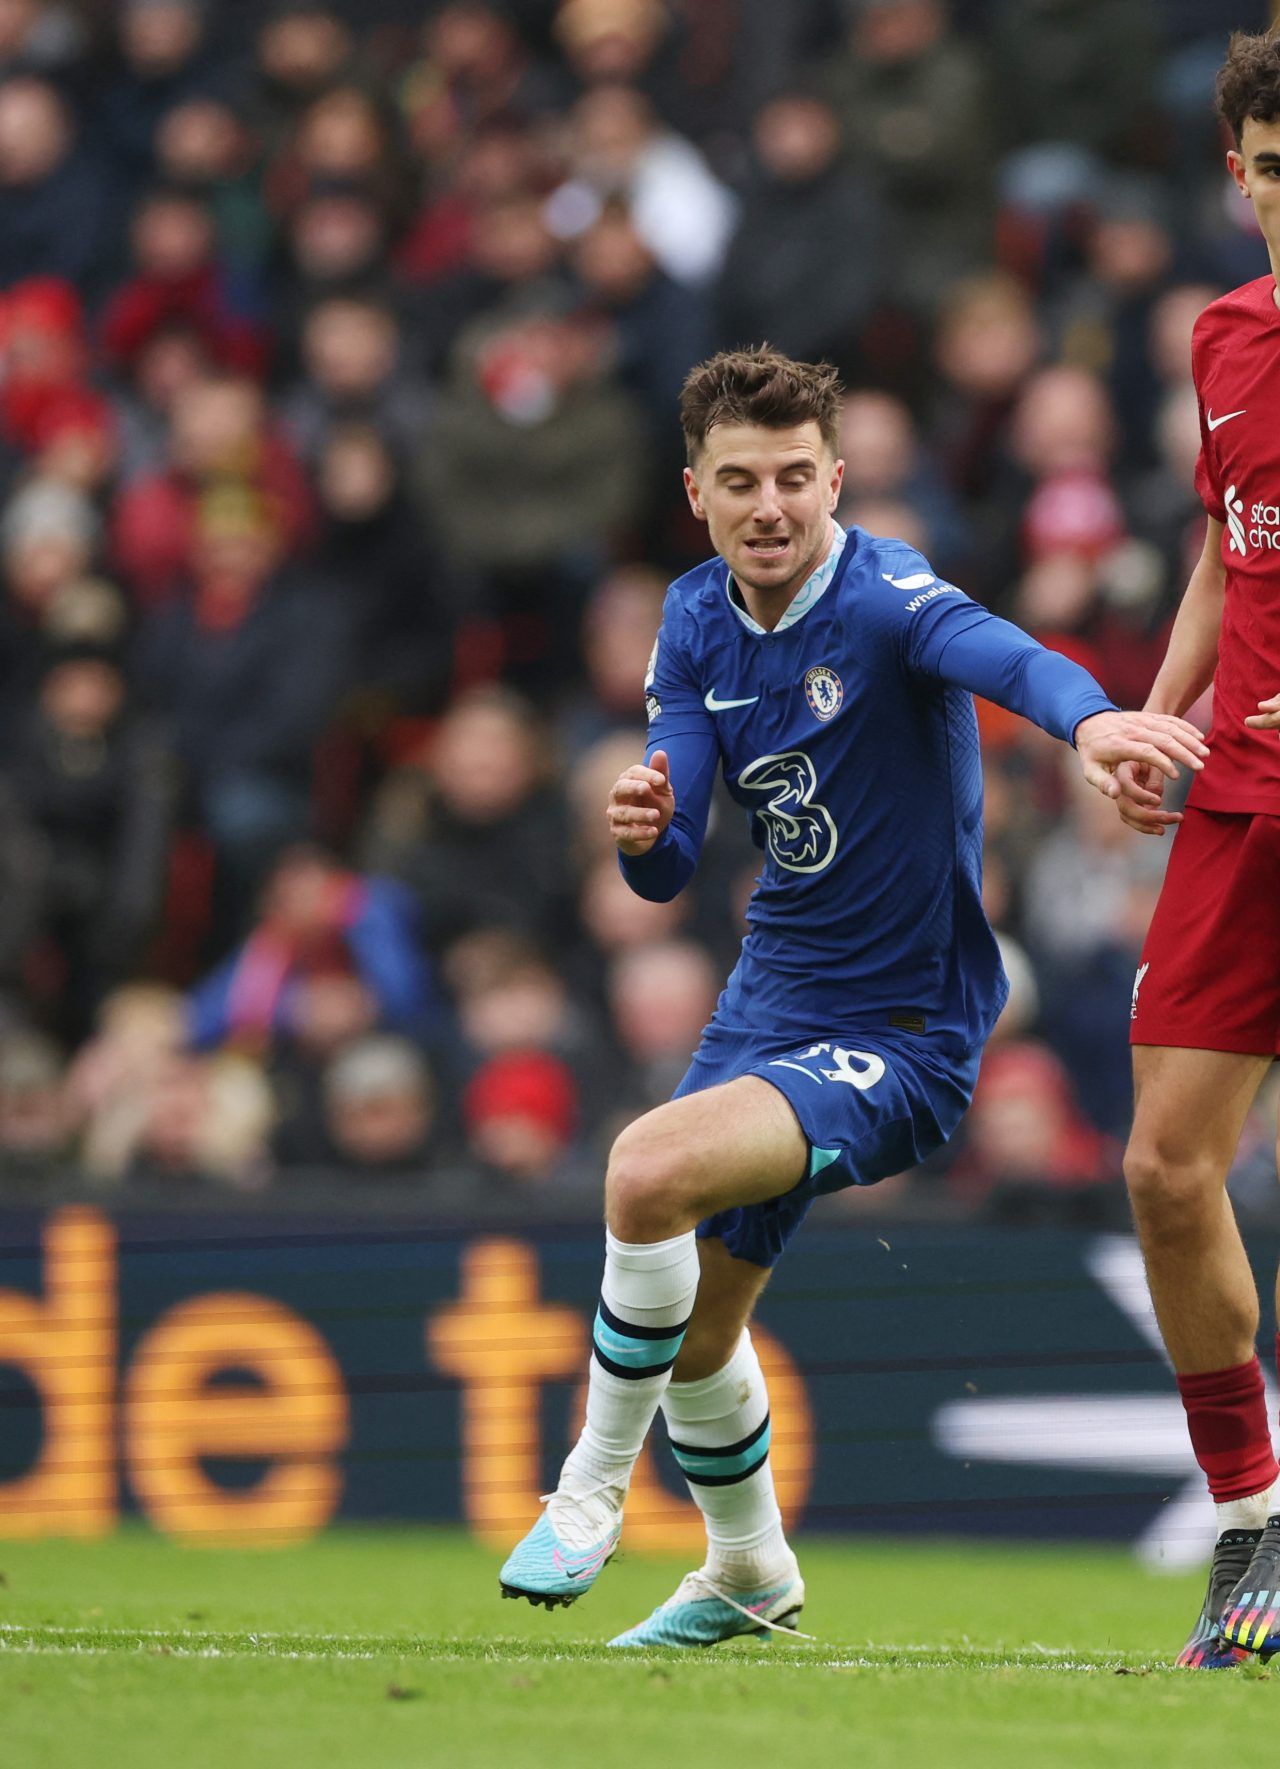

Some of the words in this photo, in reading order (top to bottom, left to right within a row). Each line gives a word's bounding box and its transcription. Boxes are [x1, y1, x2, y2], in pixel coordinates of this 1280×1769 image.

[806, 668, 831, 684] CHELSEA
[738, 751, 838, 874] 3
[0, 1204, 352, 1550] de
